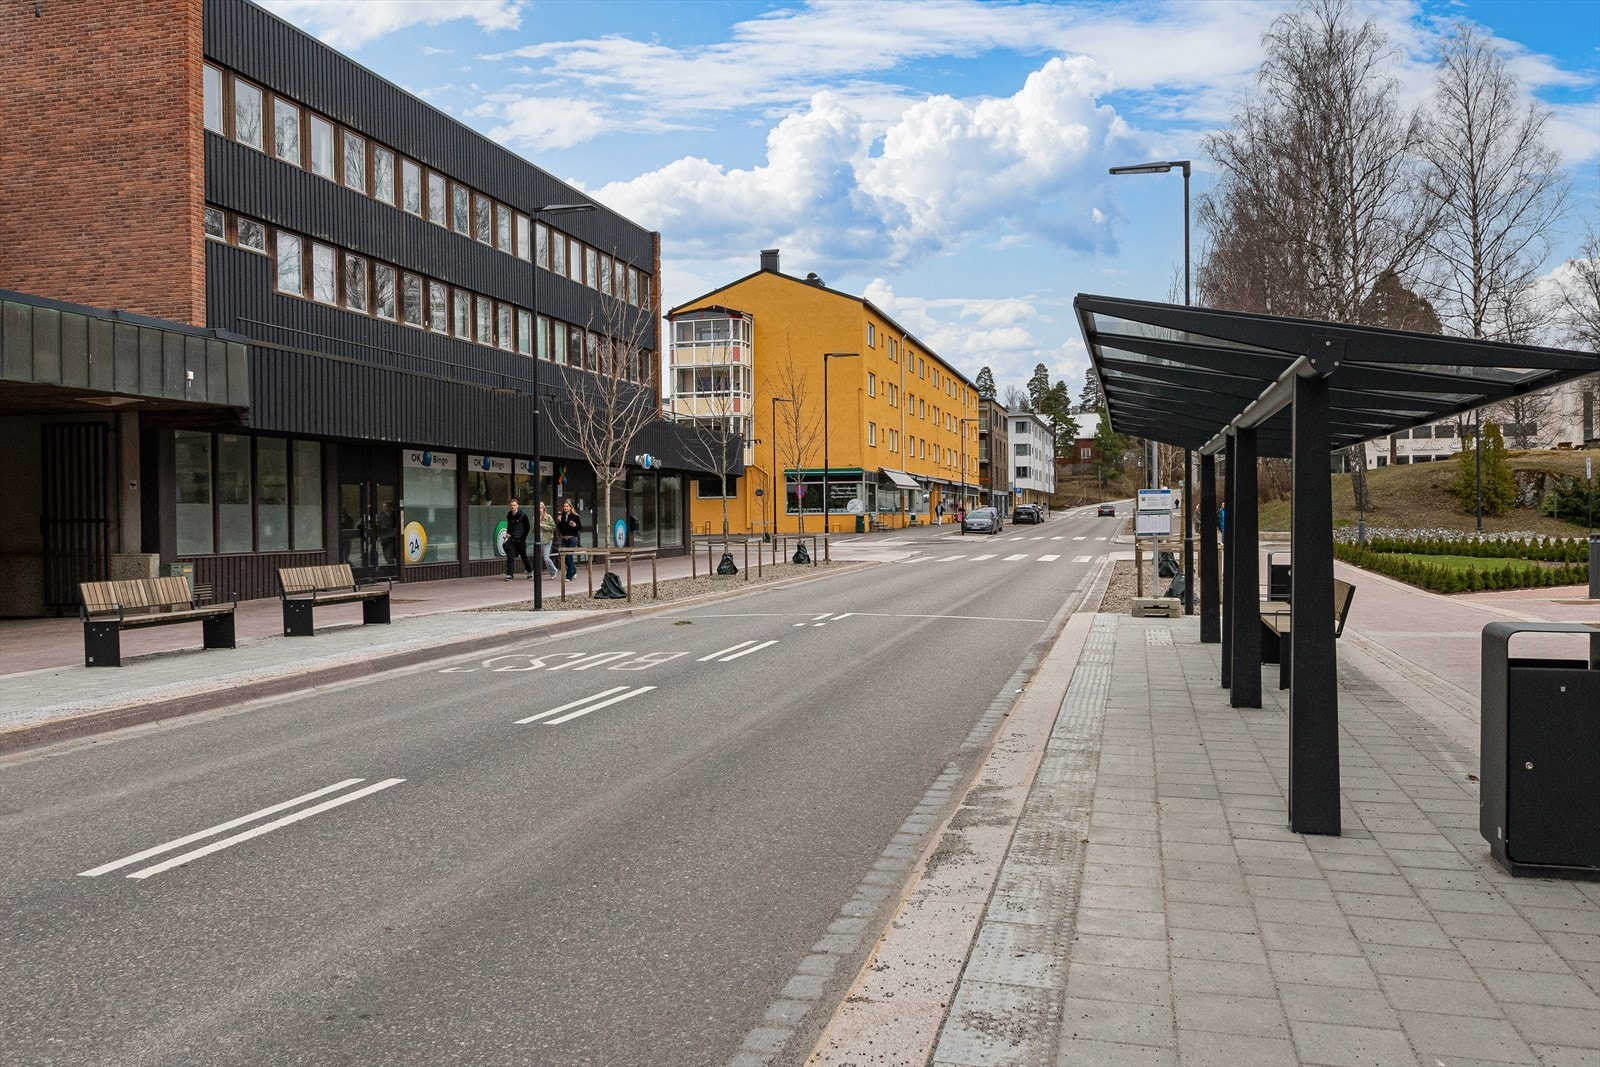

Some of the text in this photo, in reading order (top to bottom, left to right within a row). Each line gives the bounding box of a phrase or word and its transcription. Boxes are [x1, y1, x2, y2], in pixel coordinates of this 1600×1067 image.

[411, 453, 449, 467] OK Bingo
[473, 459, 504, 470] OK Bingo
[520, 462, 548, 473] OK ngo
[409, 538, 419, 554] 24
